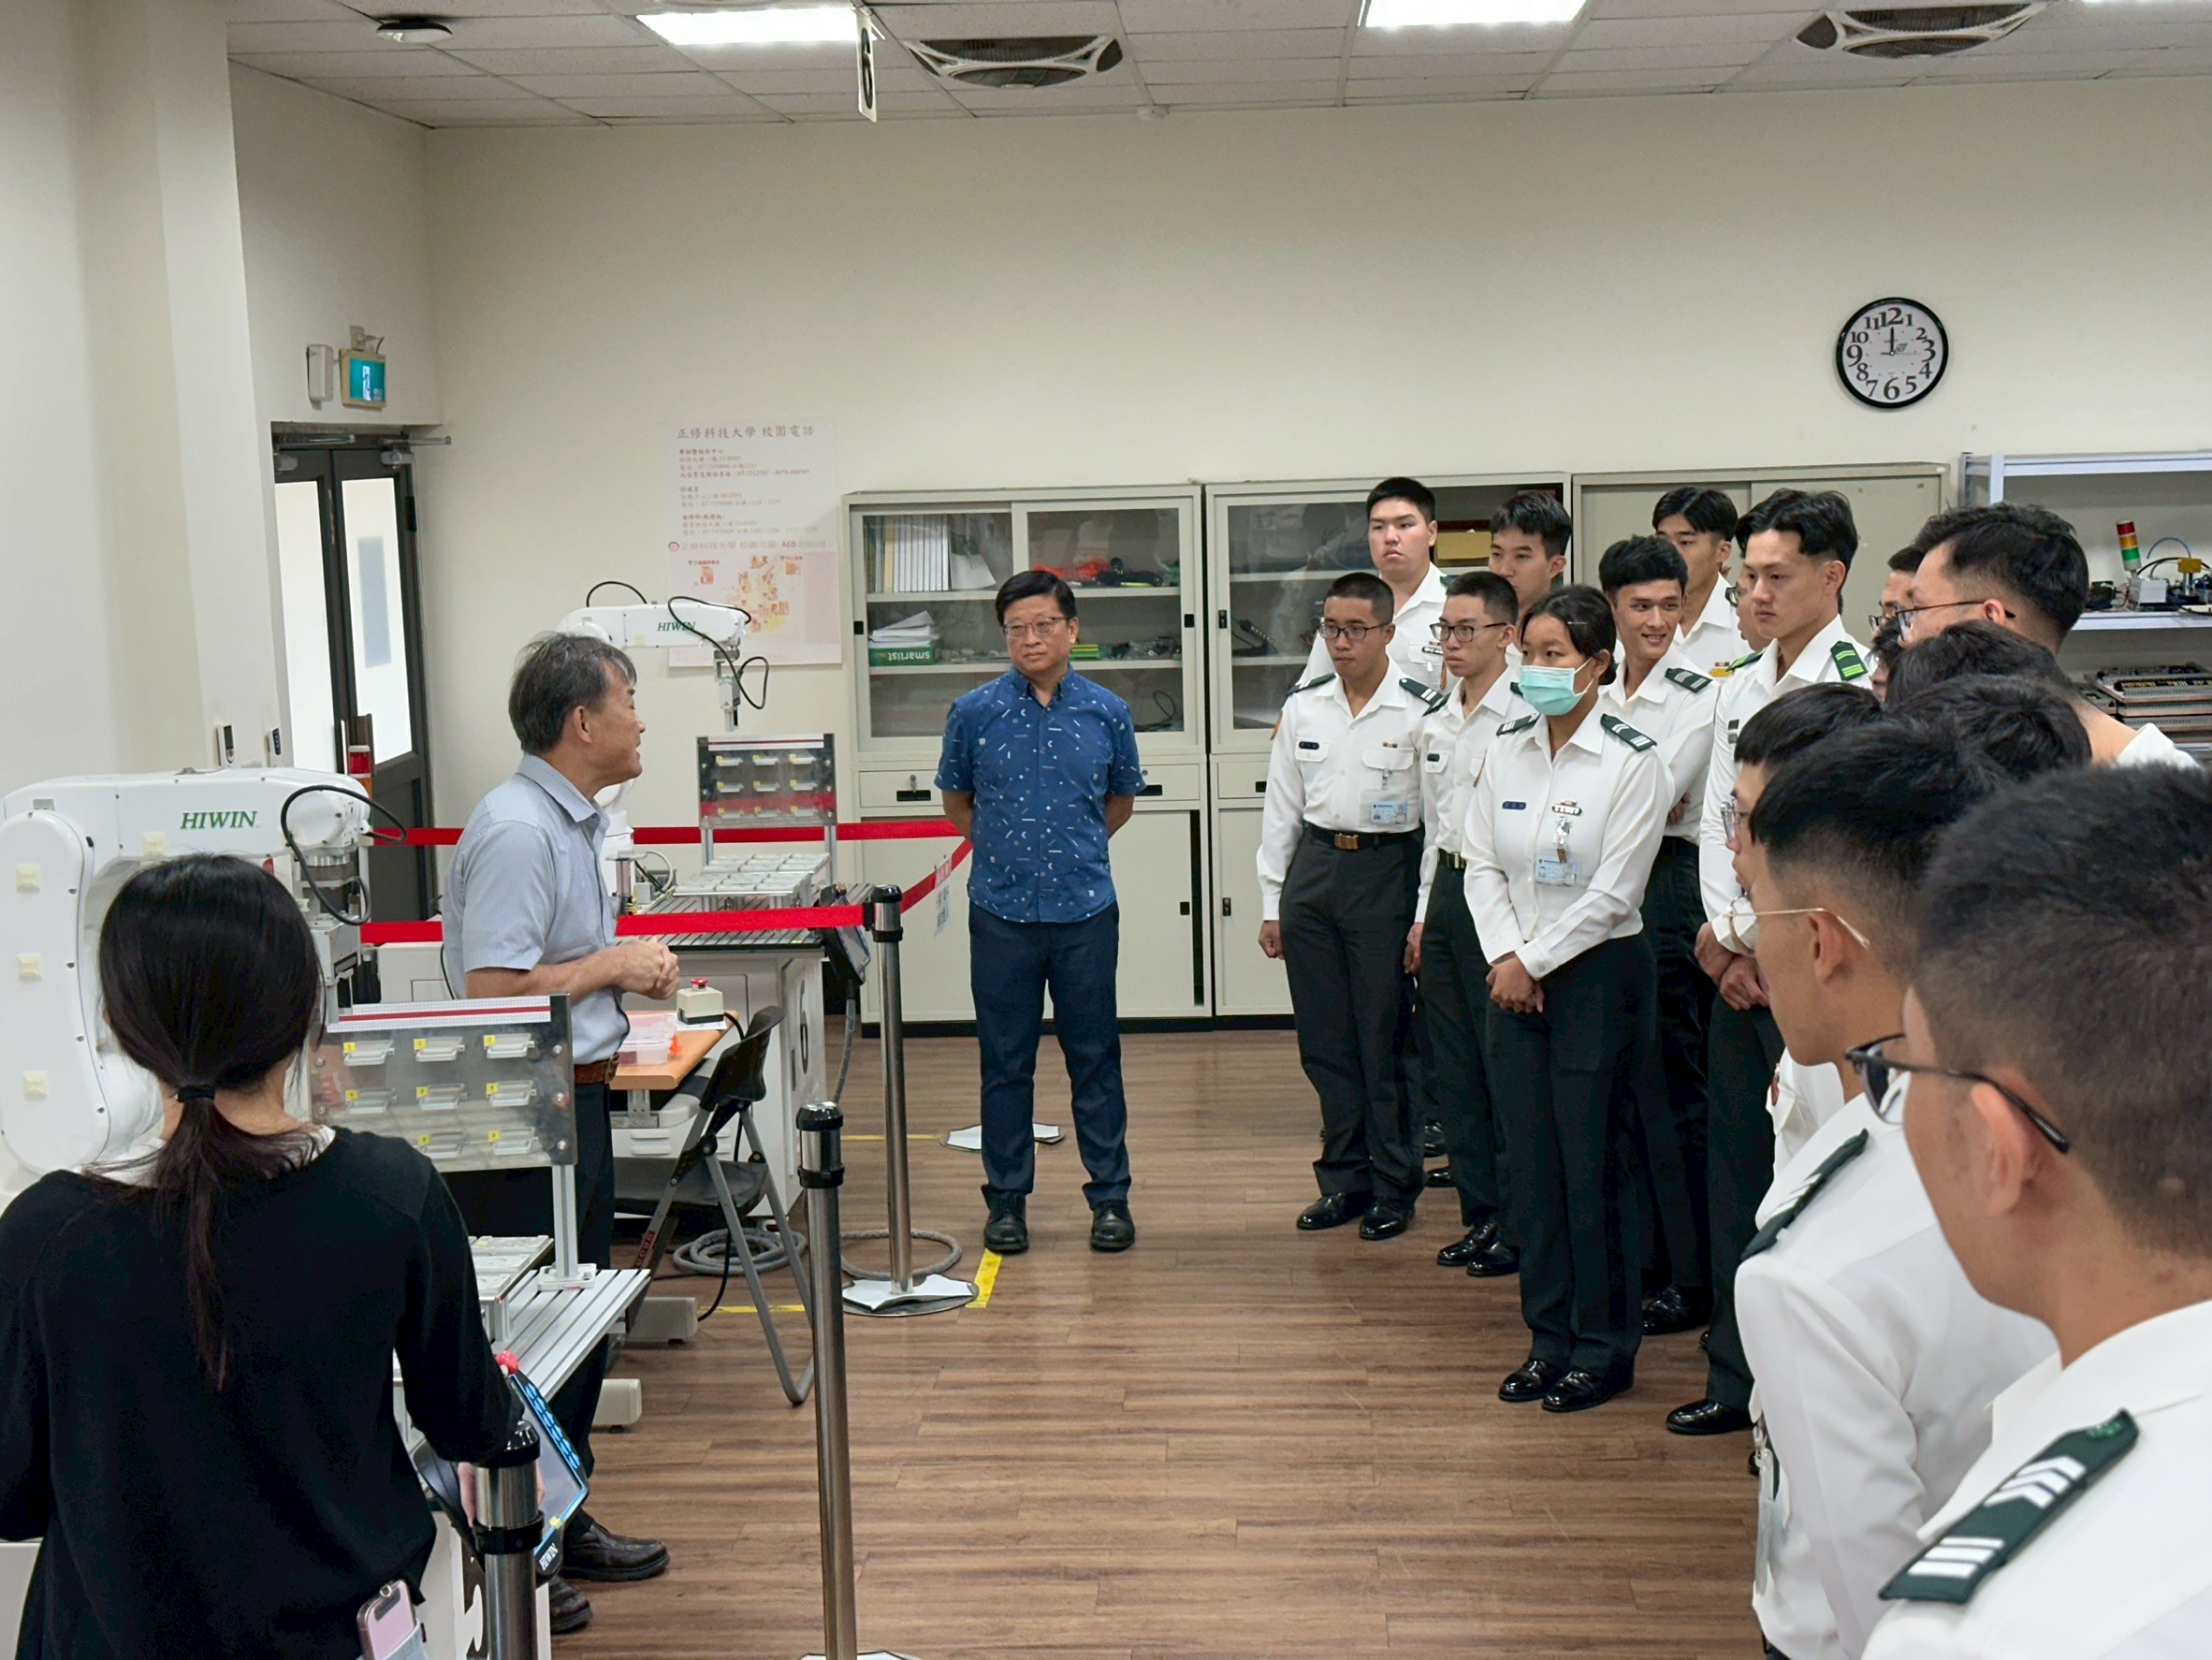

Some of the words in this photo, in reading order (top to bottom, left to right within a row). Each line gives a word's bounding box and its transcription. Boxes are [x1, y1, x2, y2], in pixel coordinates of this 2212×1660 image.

[1865, 316, 1880, 330] 11
[1878, 307, 1904, 328] 12
[1906, 313, 1913, 327] 1
[1850, 331, 1870, 343] 10
[1915, 328, 1928, 341] 2
[1846, 344, 1863, 368] 9
[1921, 339, 1936, 362] 3
[1855, 362, 1870, 381] 8
[1919, 362, 1932, 379] 4
[1866, 379, 1878, 397] 7
[1883, 377, 1900, 400] 6
[1905, 375, 1917, 394] 5
[677, 426, 756, 439] 正修科技大學
[762, 425, 814, 438] 校園電話
[657, 621, 696, 632] HIWIN
[887, 650, 930, 662] smartist
[180, 808, 257, 829] HIWIN
